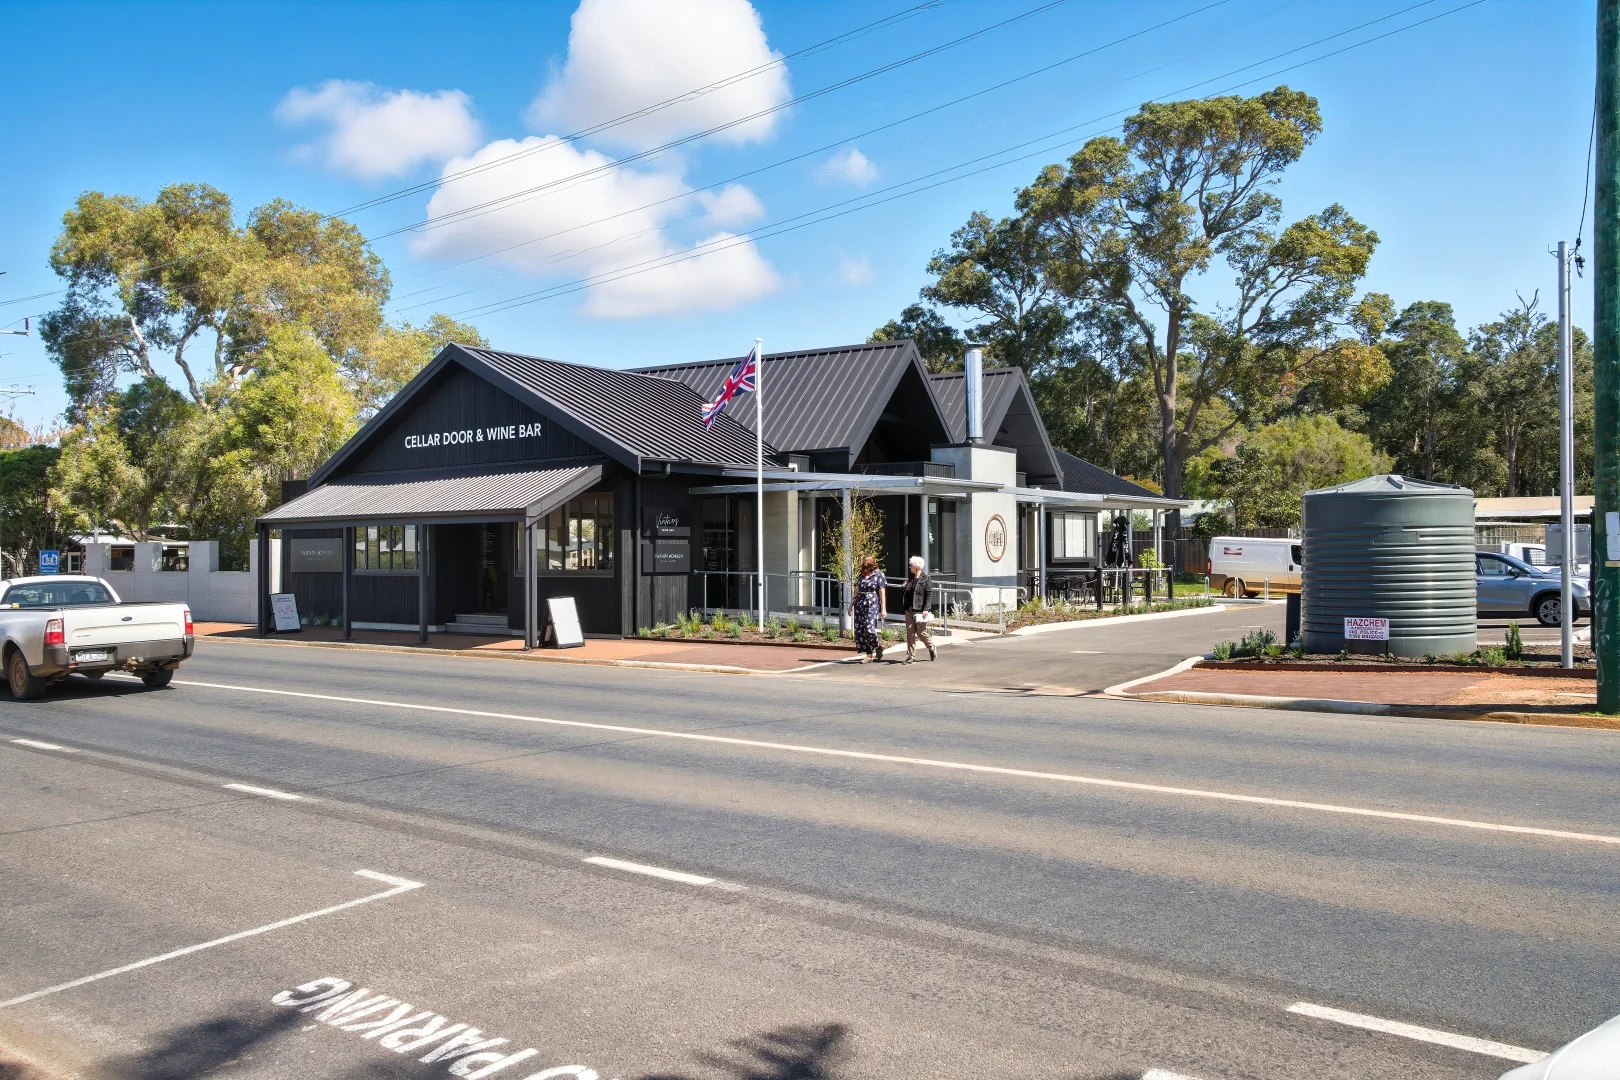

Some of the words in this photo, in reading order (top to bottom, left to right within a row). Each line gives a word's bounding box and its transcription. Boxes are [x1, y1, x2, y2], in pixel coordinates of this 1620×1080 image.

[404, 433, 440, 449] CELLAR
[443, 430, 474, 445] DOOR
[476, 428, 484, 442] &
[486, 425, 516, 441] WINE
[518, 422, 542, 438] BAR
[1347, 618, 1386, 627] HAZCHEM
[271, 976, 539, 1080] PARKING
